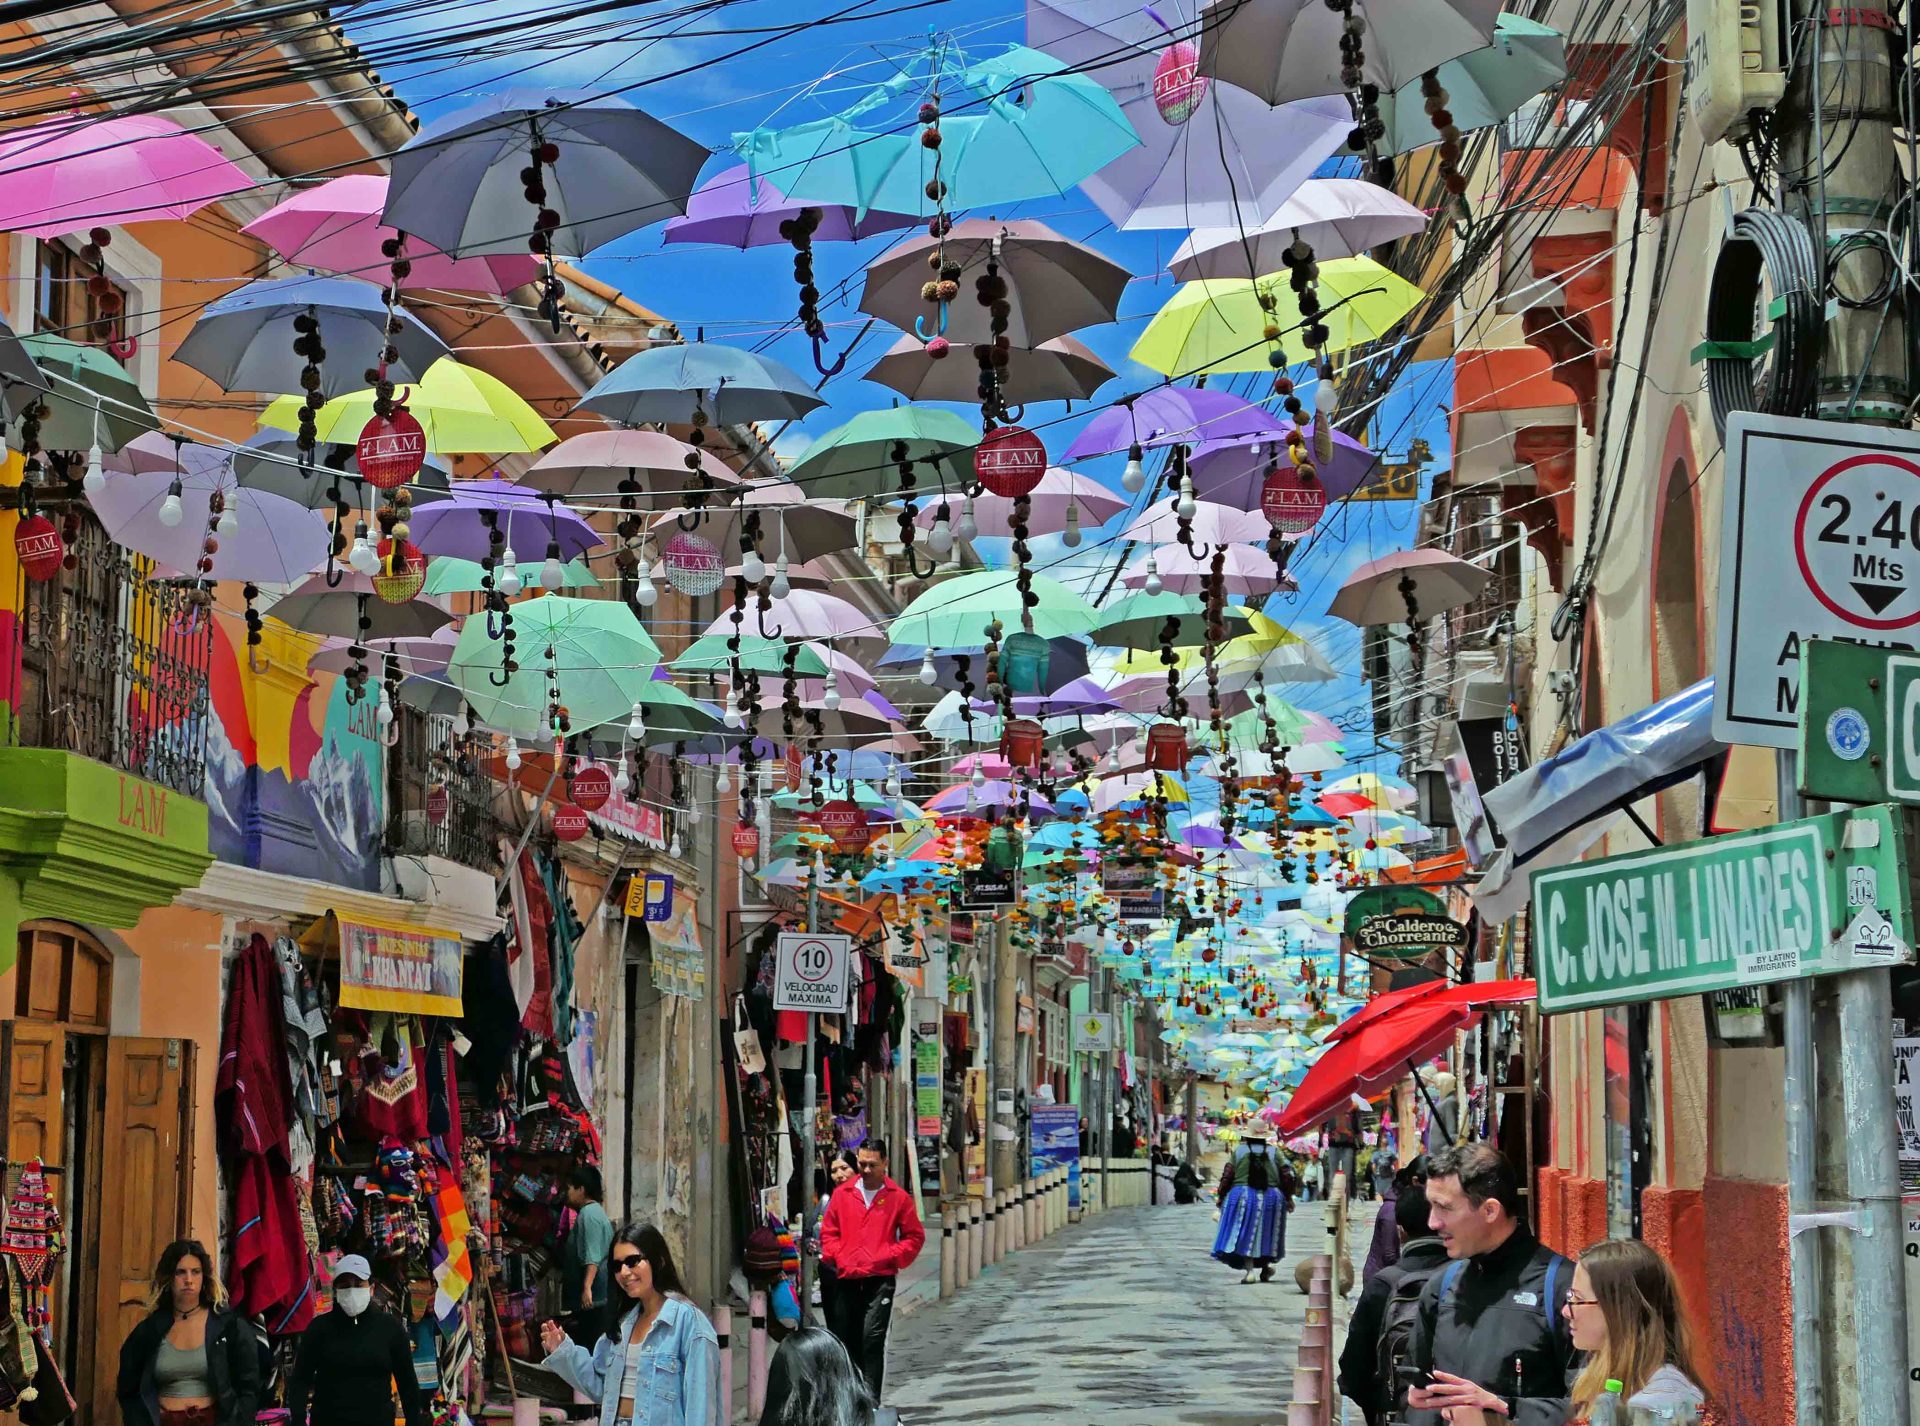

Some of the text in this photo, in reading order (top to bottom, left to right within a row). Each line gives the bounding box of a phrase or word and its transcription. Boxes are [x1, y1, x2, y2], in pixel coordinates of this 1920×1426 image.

[1853, 553, 1904, 582] Mts
[118, 775, 167, 838] LAM
[1582, 877, 1651, 983] JOSE
[1652, 871, 1688, 971] M.
[1689, 848, 1812, 965] LINARES
[1385, 919, 1444, 933] Caldero
[1366, 931, 1457, 947] Chorreante
[801, 949, 826, 968] 10
[1756, 952, 1796, 964] BY LATINO
[1748, 960, 1796, 973] IMMIGRANTS
[784, 981, 839, 994] VELOCIDAD
